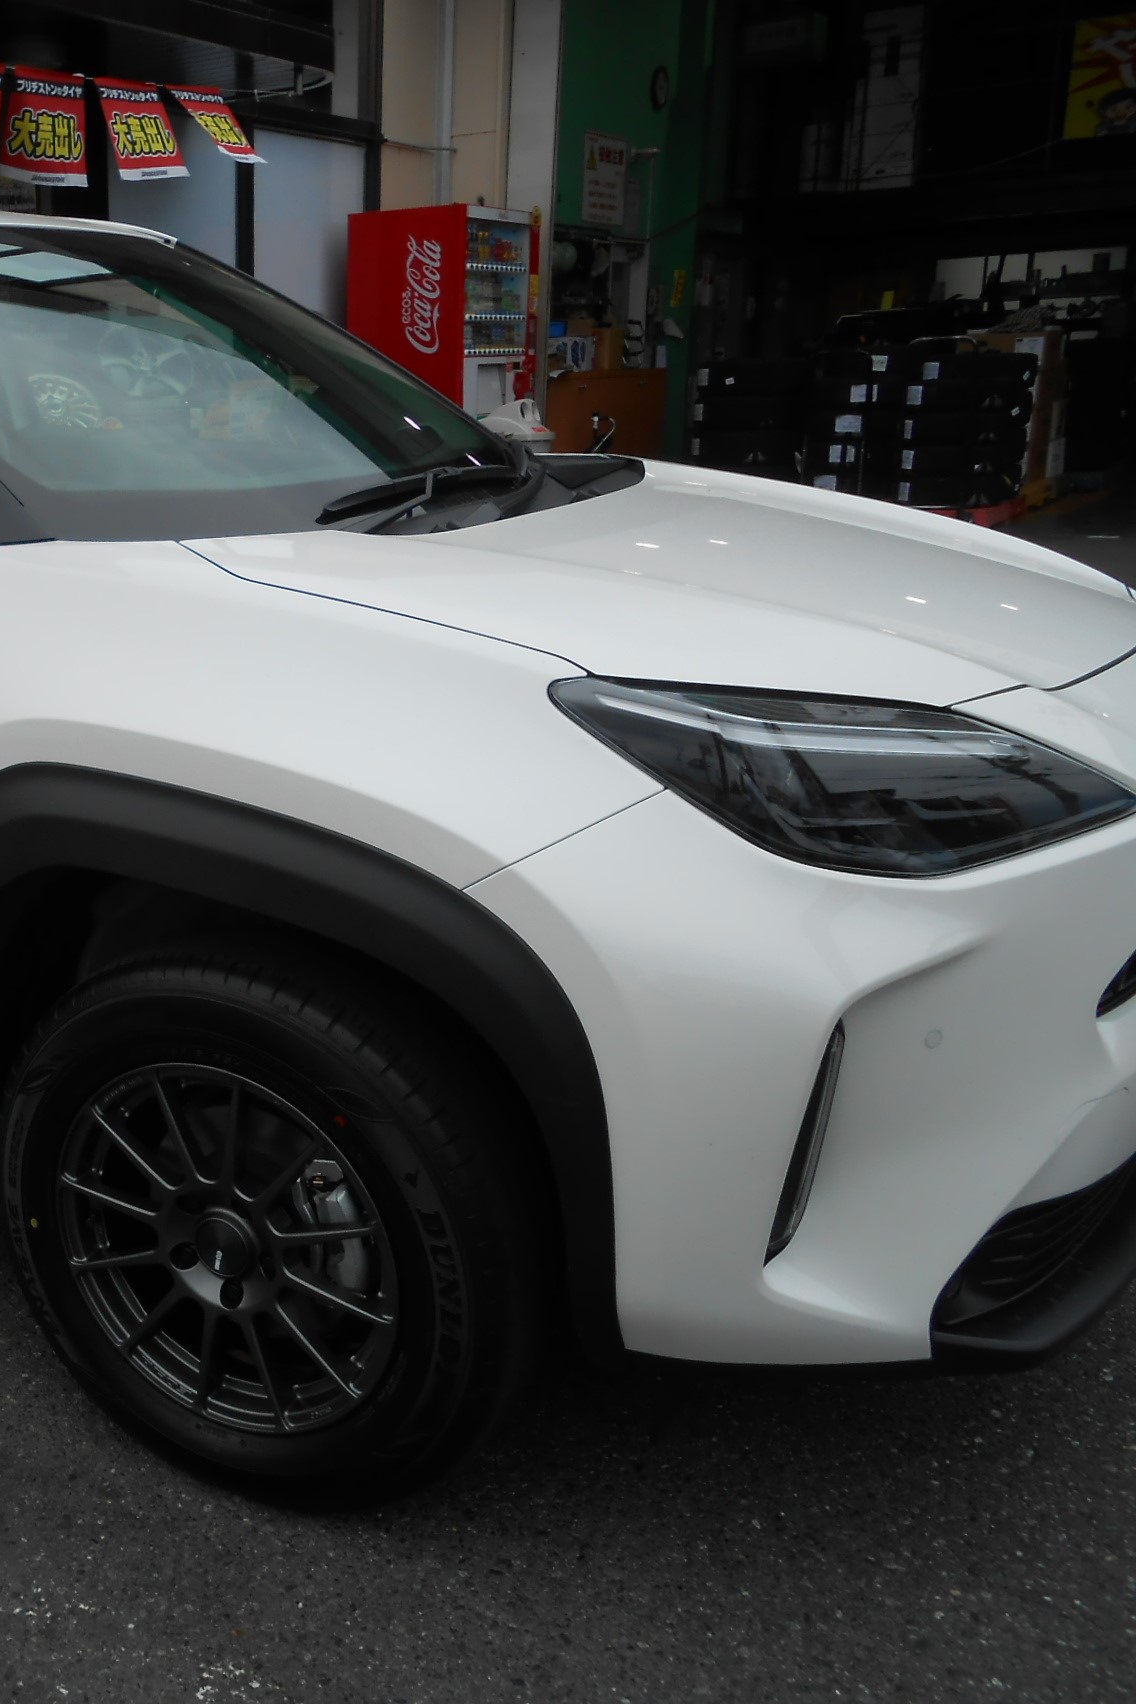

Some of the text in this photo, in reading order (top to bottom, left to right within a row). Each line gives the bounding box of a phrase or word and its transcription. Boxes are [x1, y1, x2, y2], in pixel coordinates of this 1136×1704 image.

[7, 107, 84, 162] 大売出し
[111, 111, 178, 159] 大売出し
[405, 234, 441, 354] Coca-Cola
